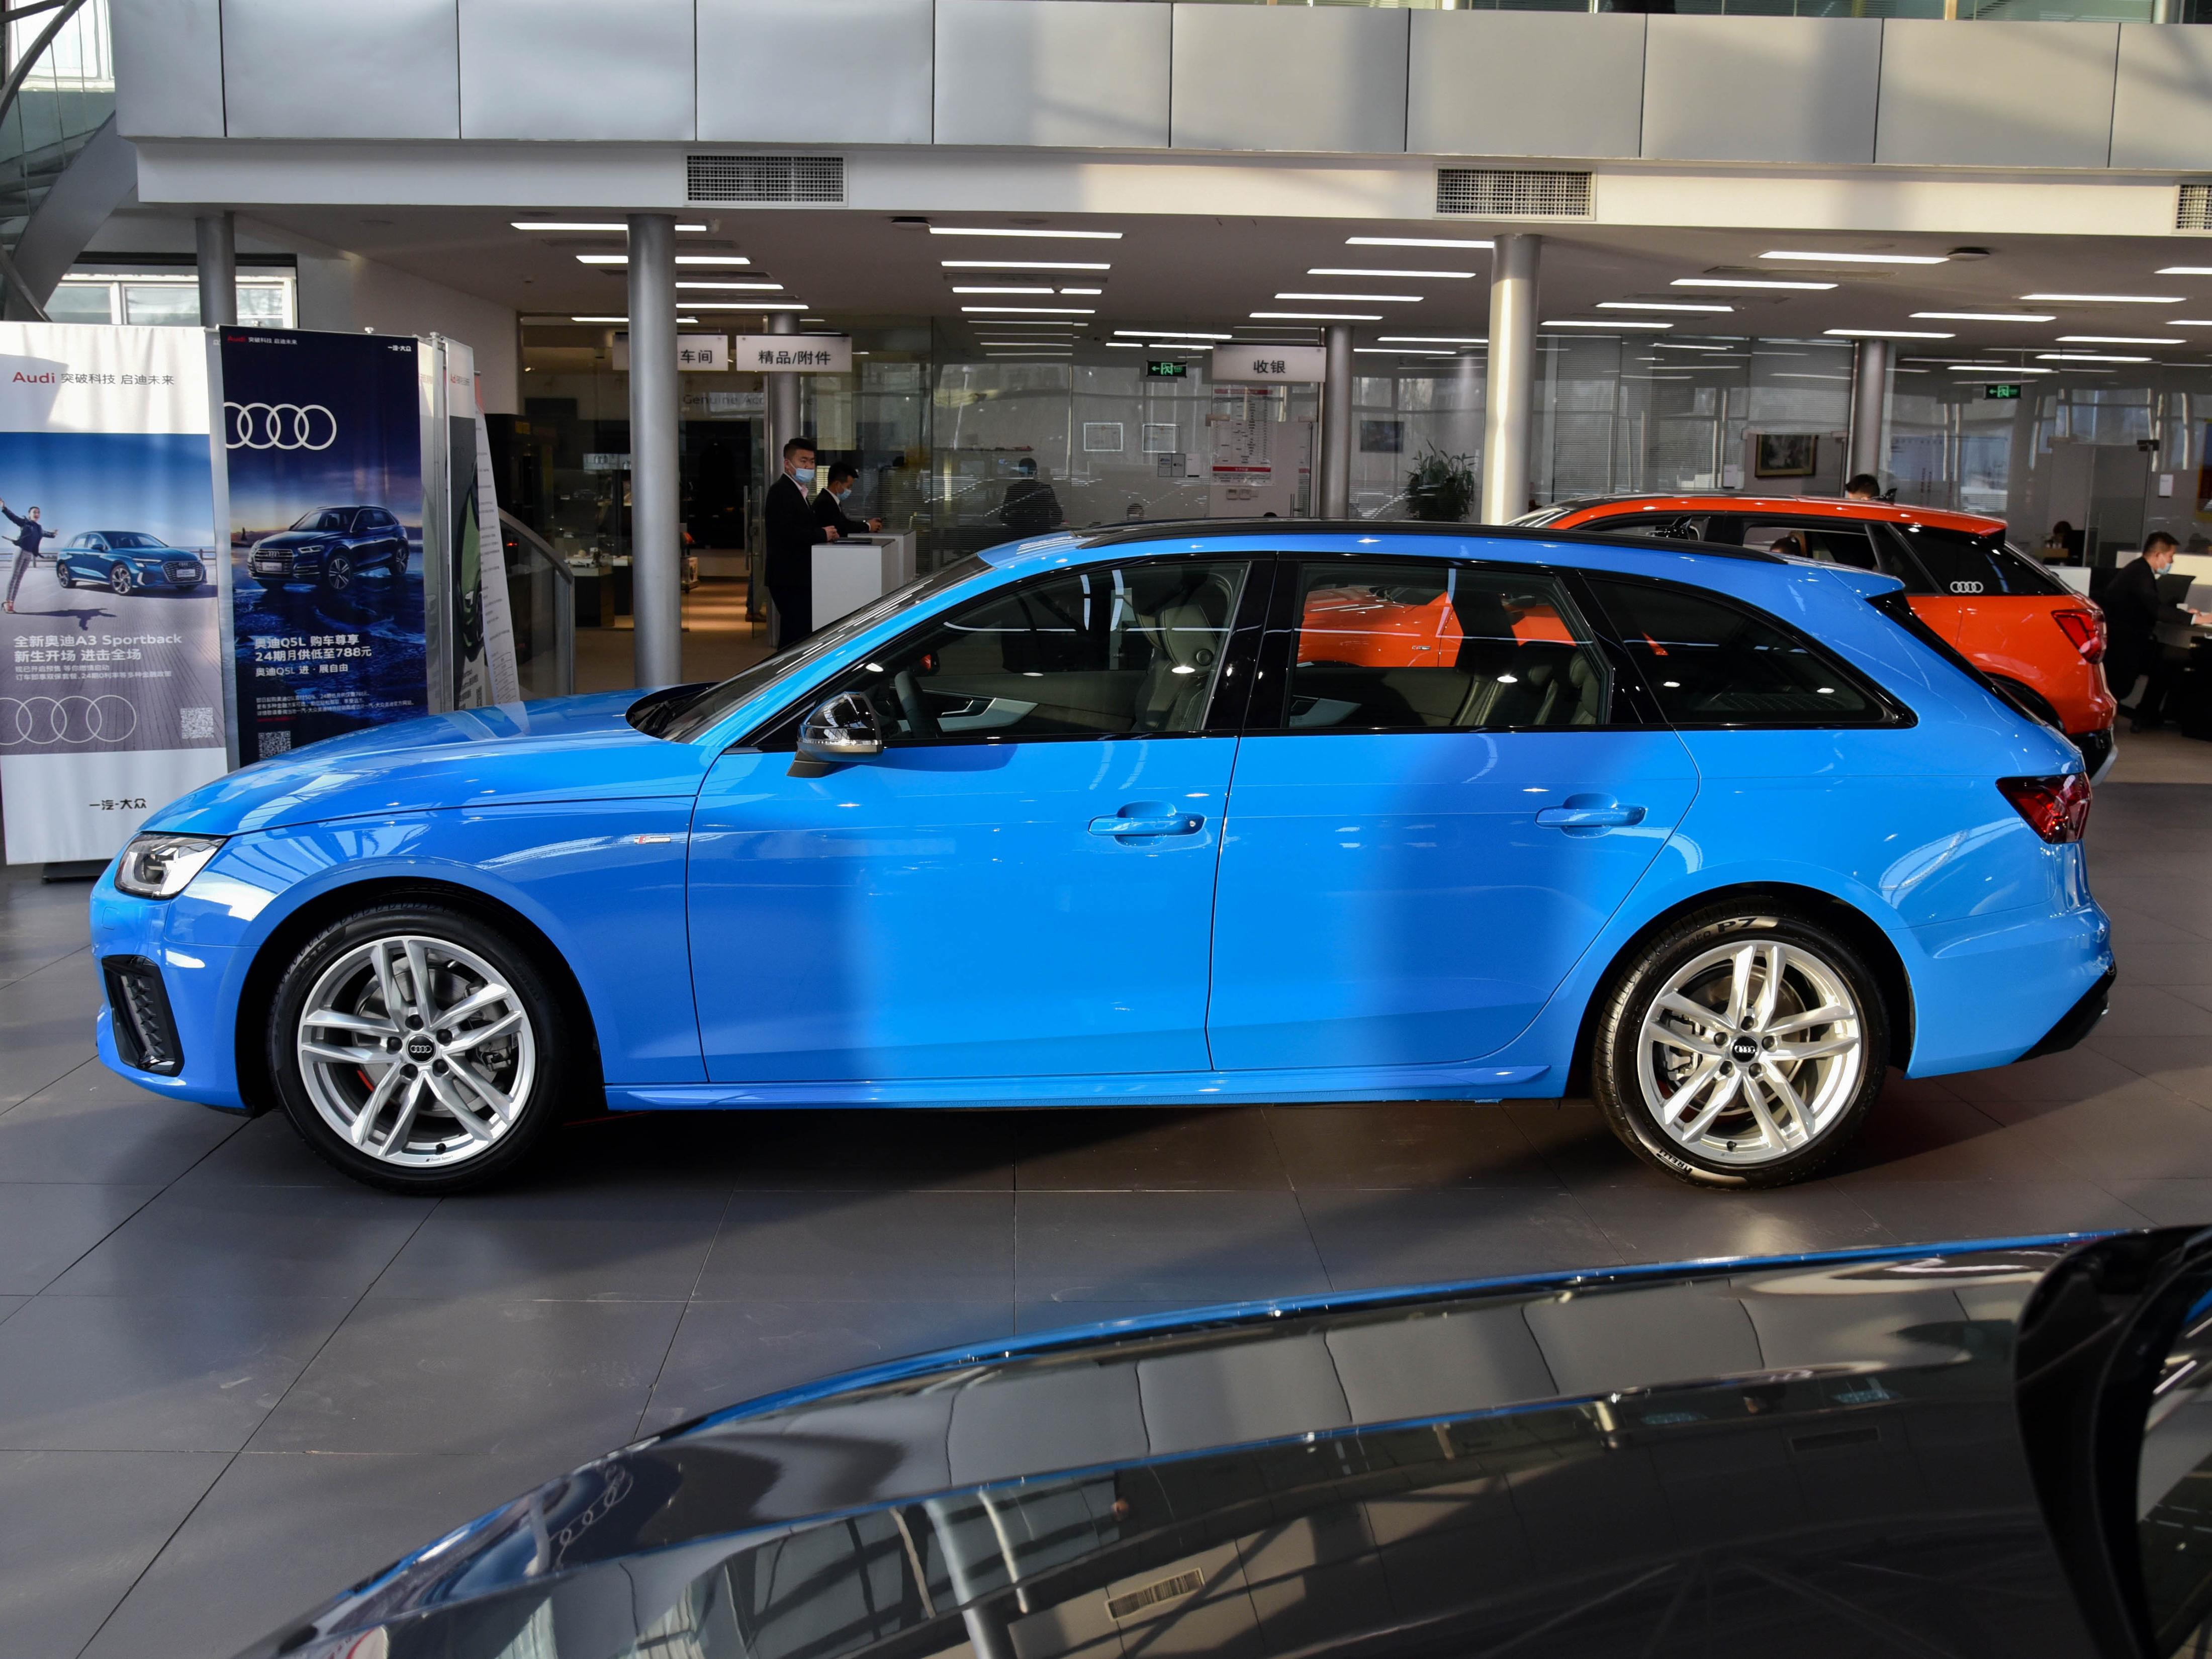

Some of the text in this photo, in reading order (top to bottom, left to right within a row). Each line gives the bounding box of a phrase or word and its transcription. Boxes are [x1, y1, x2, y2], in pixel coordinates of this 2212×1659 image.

[758, 350, 832, 365] 精品/附件
[1253, 359, 1285, 374] 收银
[12, 372, 174, 385] Audi 突破科技 启迪未来
[683, 394, 738, 405] Genuine
[13, 634, 182, 648] 全新奥迪A3 Sportback
[254, 634, 360, 650] 奥迪Q5L 购车尊享
[14, 649, 141, 663] 新生开场 进击全场
[255, 646, 373, 662] 24期月供低至788元
[255, 667, 296, 677] 奥迪Q5L
[1717, 917, 1758, 934] P7
[1656, 1149, 1693, 1175] PIRELLI
